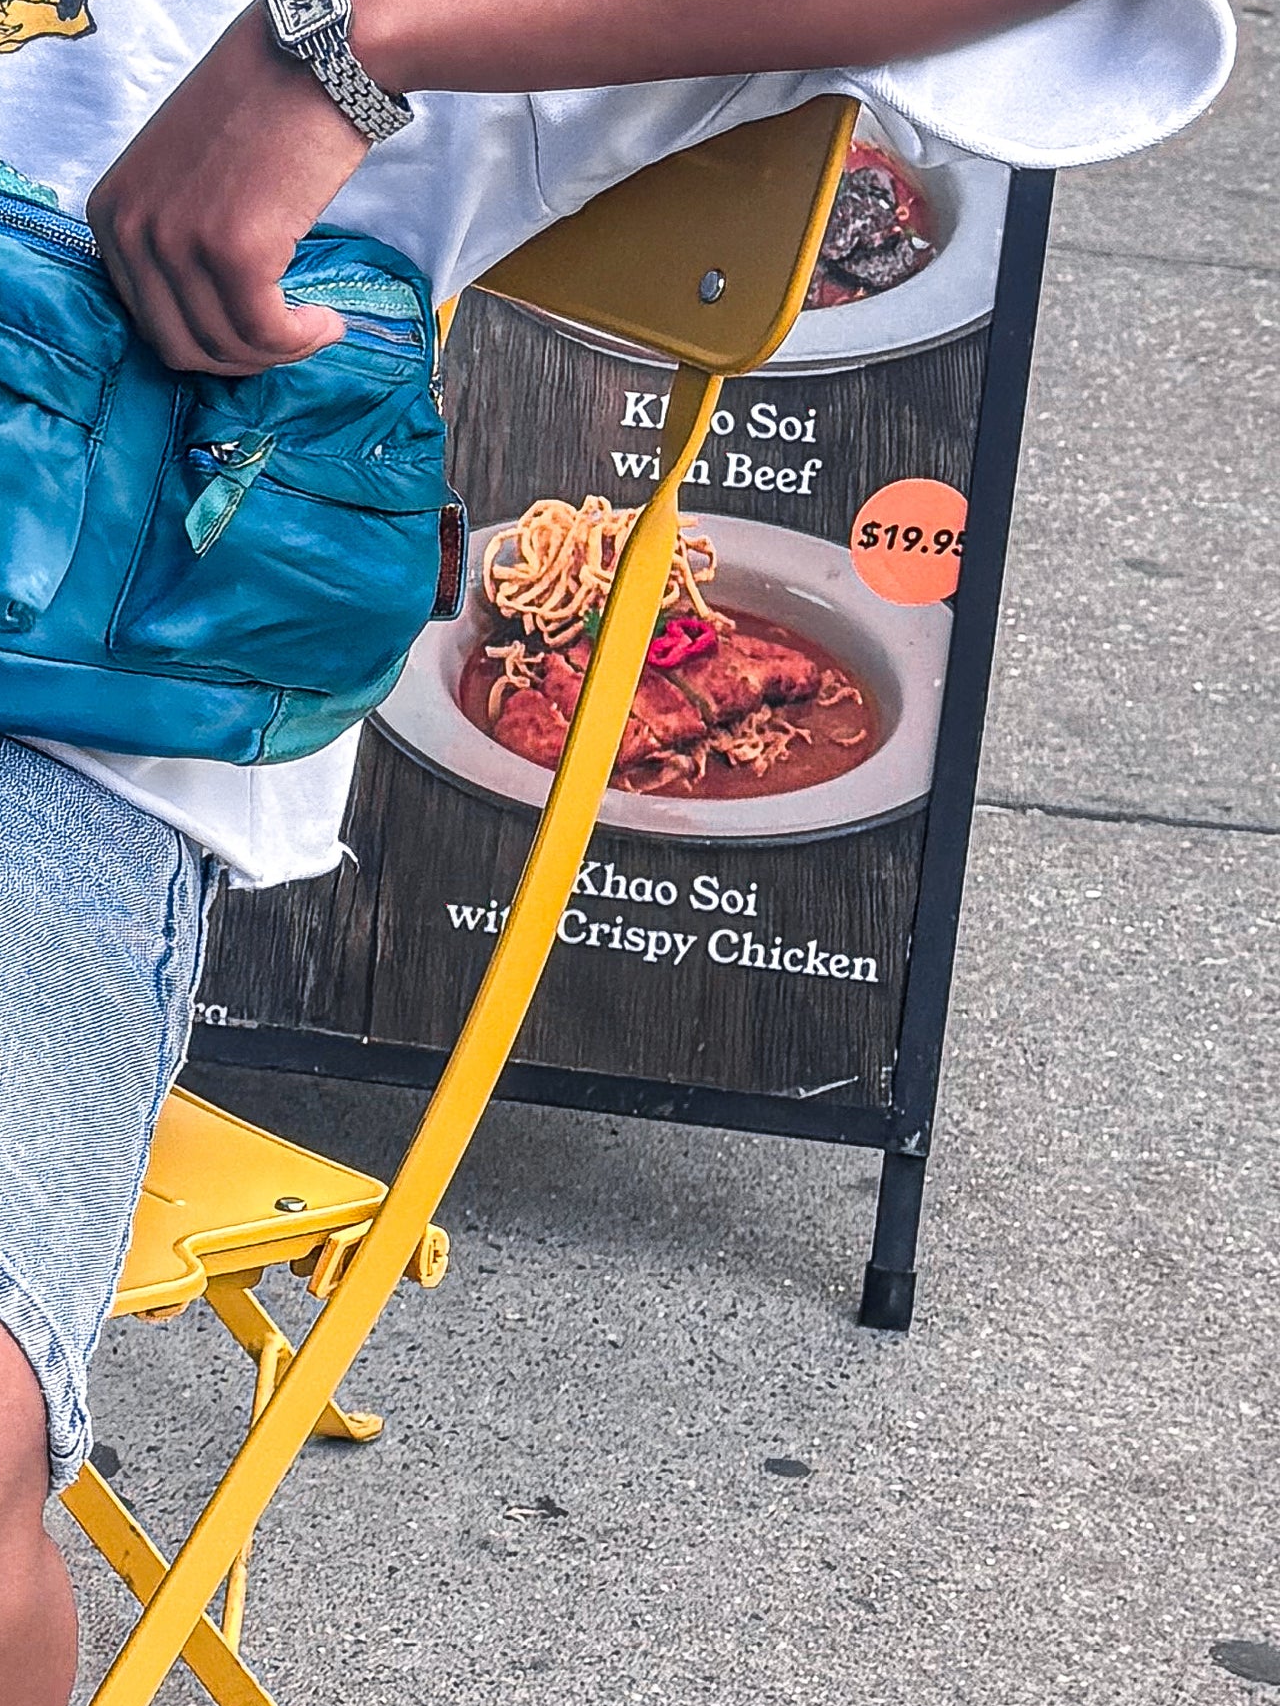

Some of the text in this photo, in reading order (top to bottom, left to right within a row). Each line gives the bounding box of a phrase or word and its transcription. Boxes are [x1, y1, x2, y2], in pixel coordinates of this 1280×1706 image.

[620, 390, 817, 444] Ko Soi
[610, 446, 823, 496] wih Beef
[570, 859, 759, 918] Khao Soi
[445, 899, 881, 985] wit Crispy Chicken
